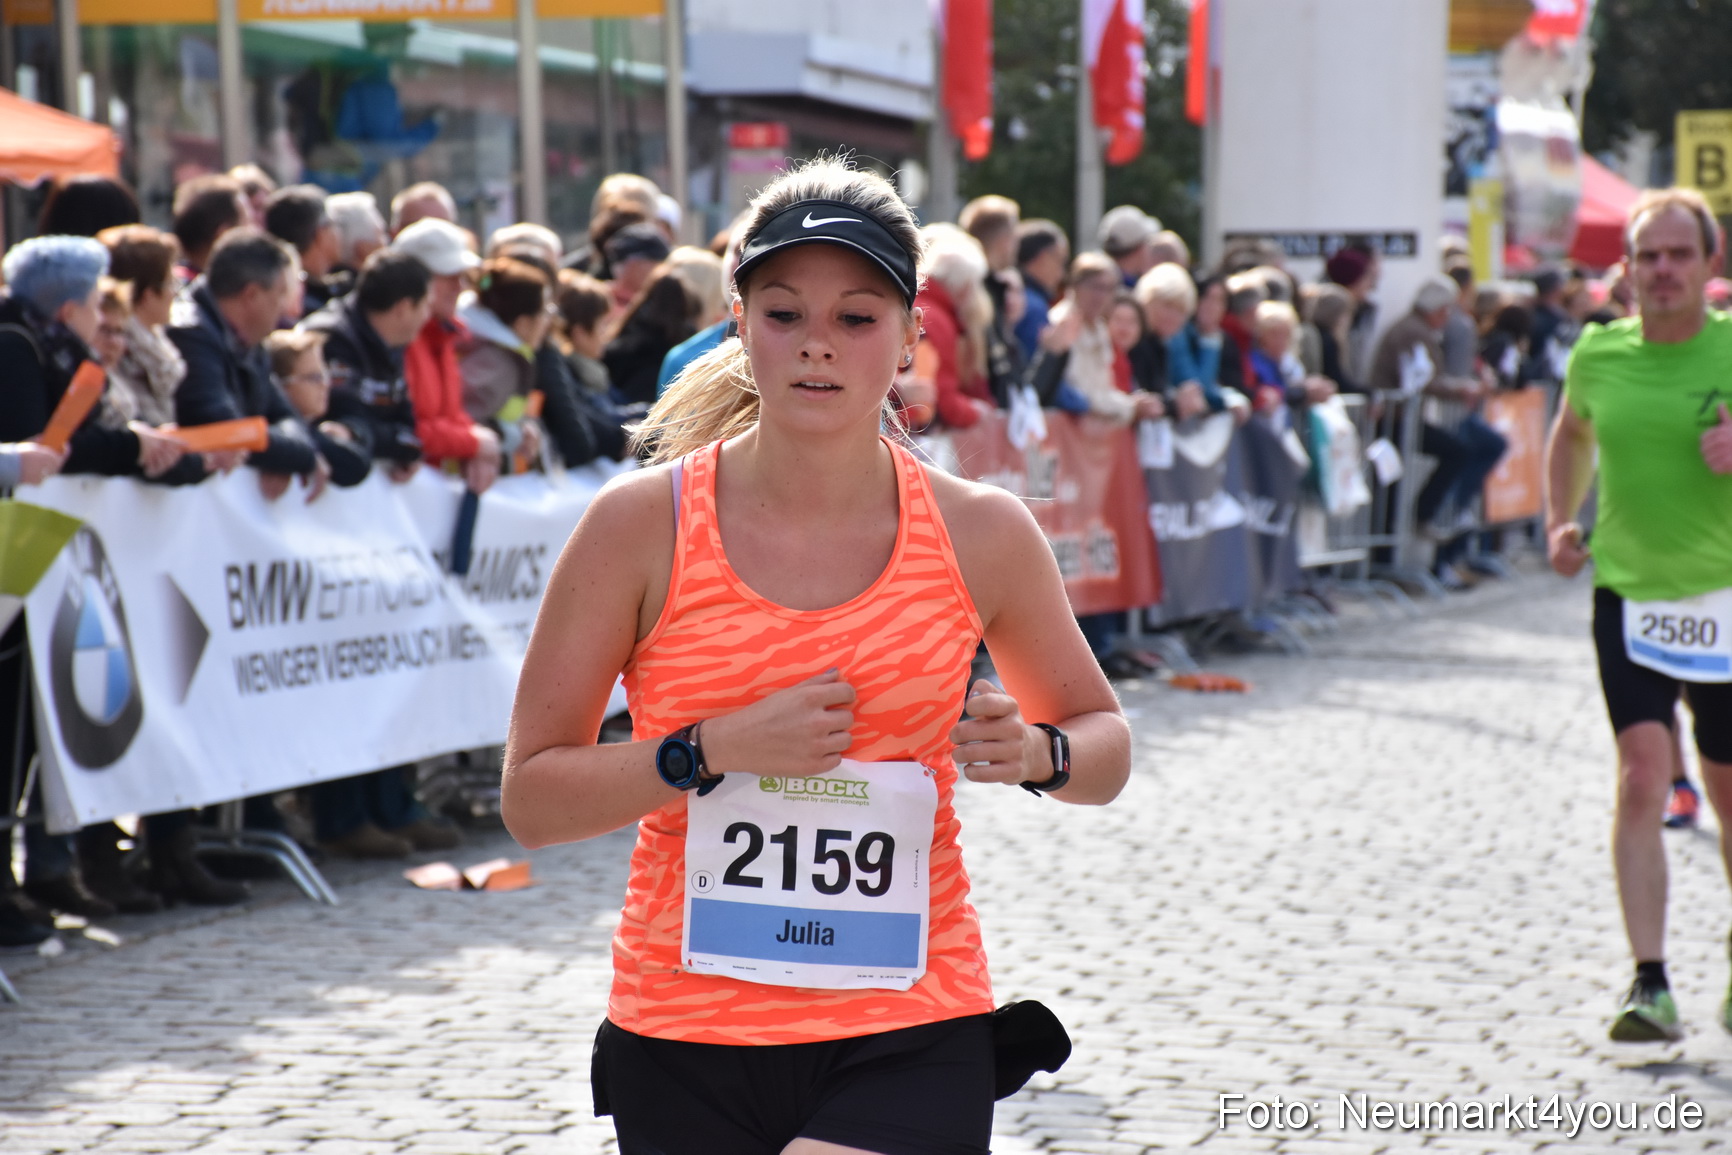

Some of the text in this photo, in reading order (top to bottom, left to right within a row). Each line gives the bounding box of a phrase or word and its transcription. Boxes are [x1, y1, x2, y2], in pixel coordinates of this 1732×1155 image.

[225, 559, 313, 630] BMW
[1641, 612, 1718, 648] 2580
[232, 645, 321, 696] WENIGER
[783, 794, 809, 802] inspired
[840, 799, 870, 807] concepts
[784, 777, 869, 799] BOCK
[722, 821, 896, 898] 2159
[699, 876, 707, 888] D
[776, 919, 834, 946] Julia
